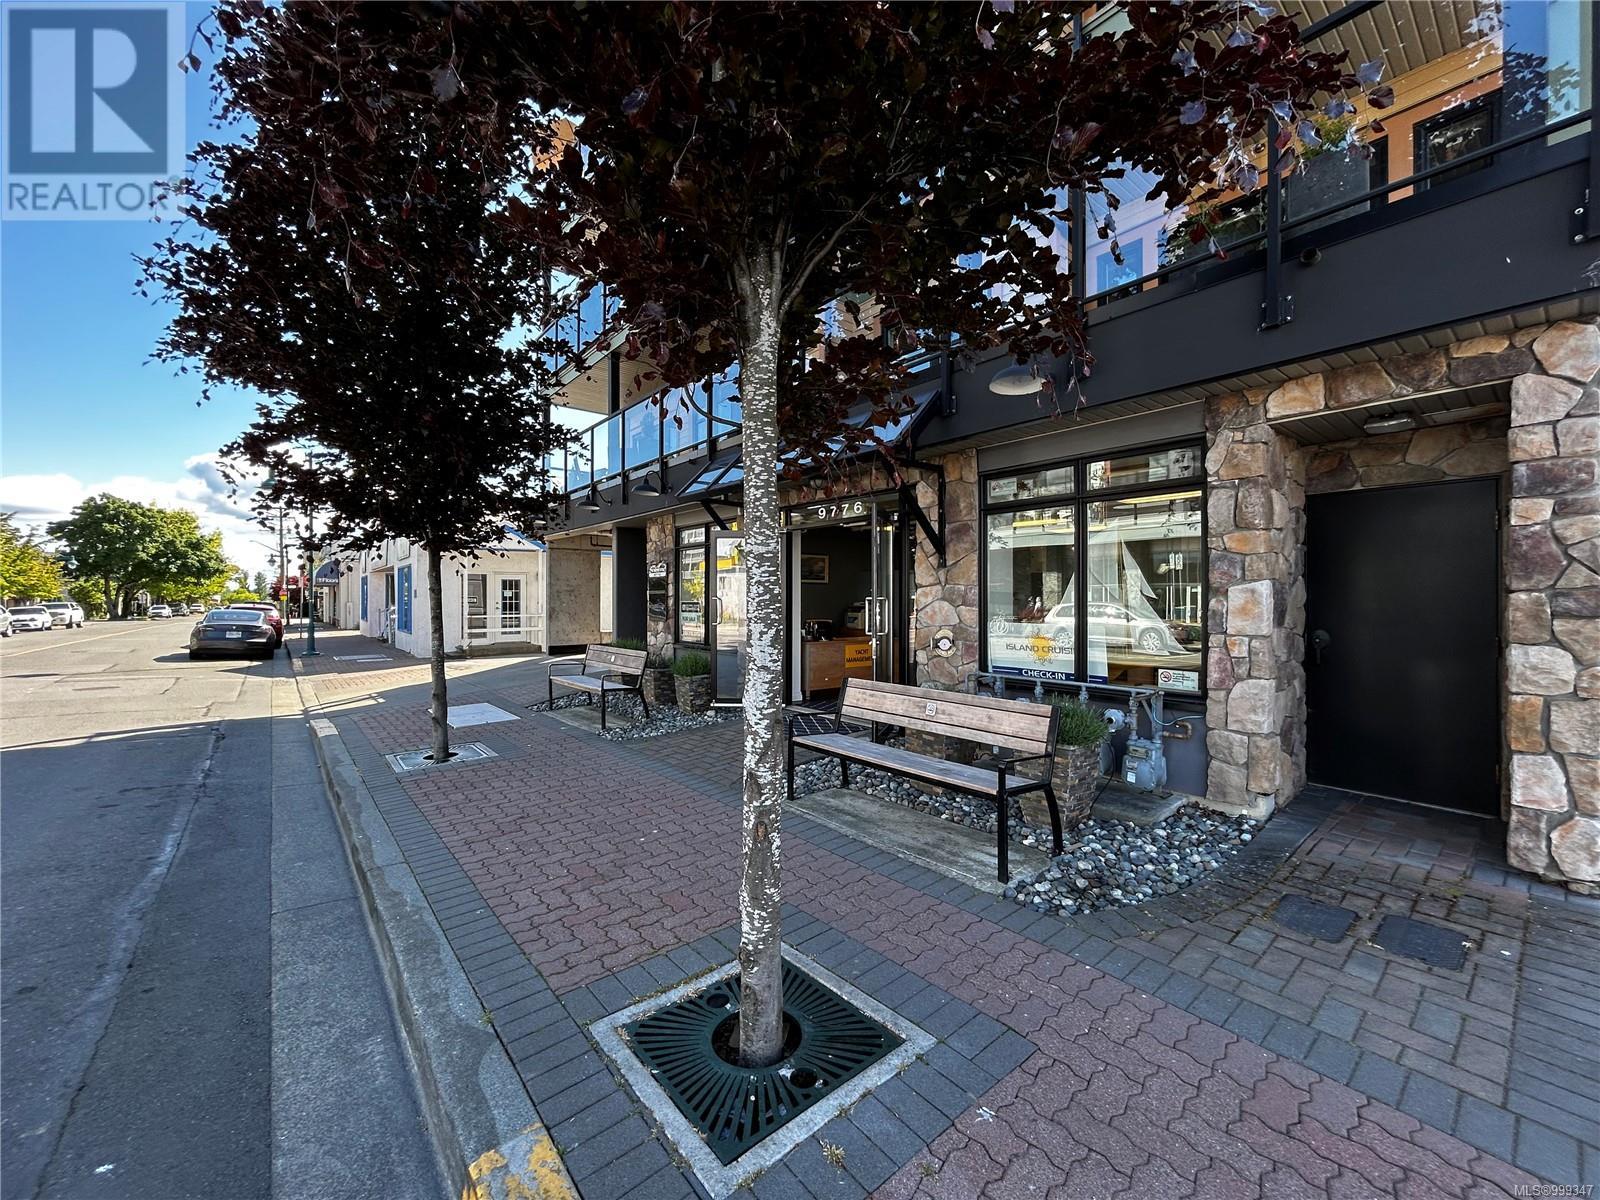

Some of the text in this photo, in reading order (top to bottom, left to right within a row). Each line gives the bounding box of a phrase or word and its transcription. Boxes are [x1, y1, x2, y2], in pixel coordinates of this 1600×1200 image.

[817, 501, 863, 520] 9776
[1005, 642, 1040, 653] ISLAND
[1021, 669, 1066, 681] CHECK-IN
